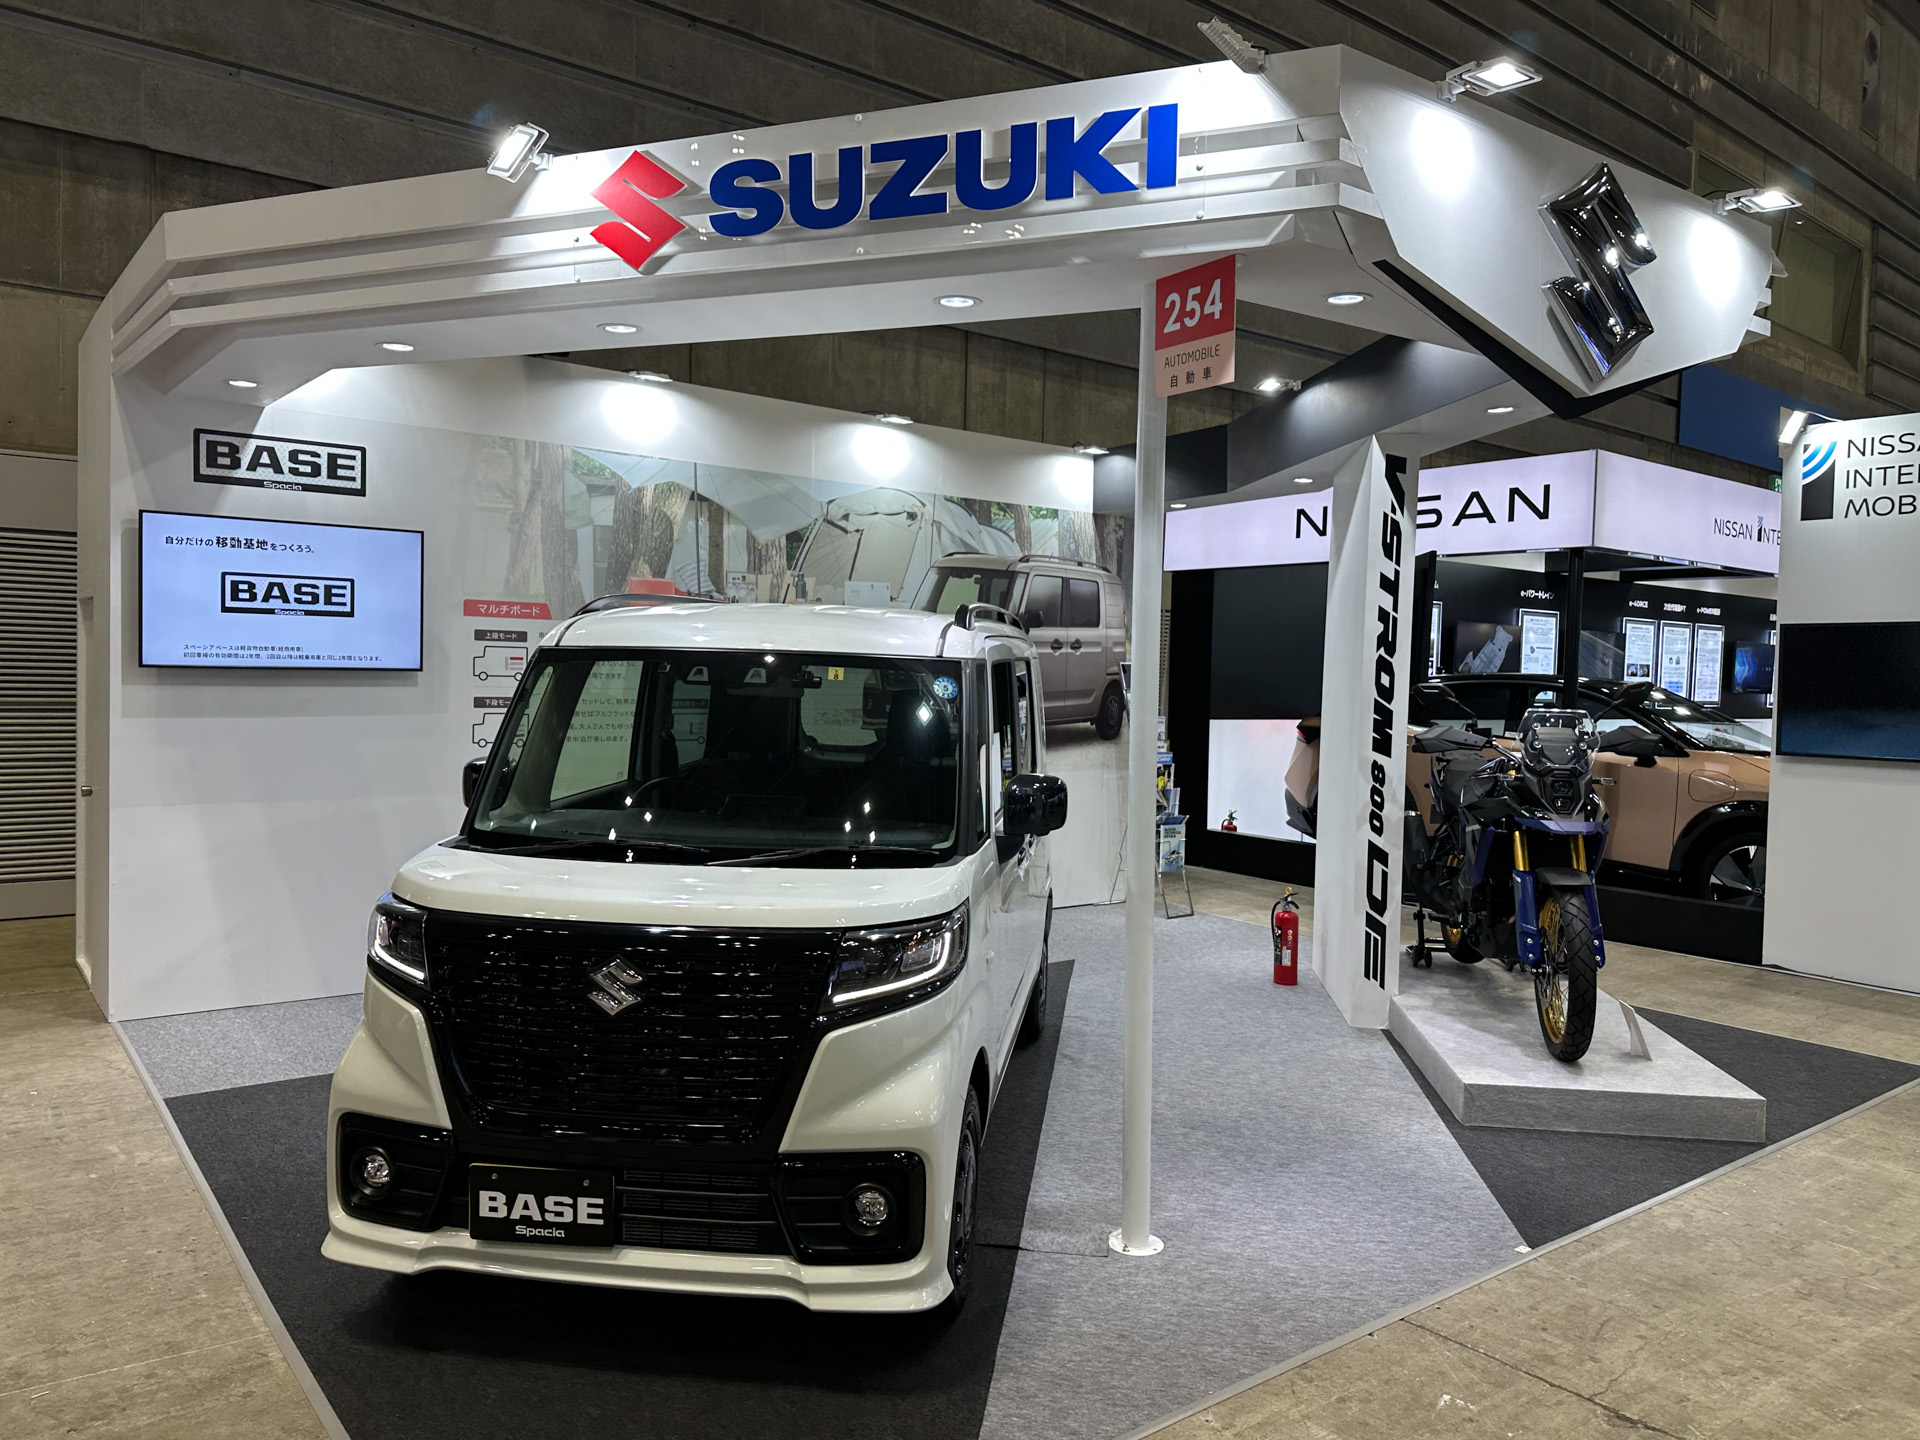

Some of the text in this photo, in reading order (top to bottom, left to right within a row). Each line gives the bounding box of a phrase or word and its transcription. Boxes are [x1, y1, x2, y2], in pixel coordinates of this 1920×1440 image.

[709, 103, 1178, 238] SUZUKI
[1163, 278, 1222, 333] 254
[1164, 344, 1220, 368] AUTOMOBILE
[1170, 367, 1212, 388] 自動車
[1847, 432, 1920, 459] NISS
[205, 440, 357, 481] BASE
[263, 481, 302, 491] Spacia
[1845, 463, 1920, 489] INTE
[1713, 517, 1753, 541] NISSAN
[165, 535, 315, 554] 自分だけの移動基地をつくろう。
[230, 580, 348, 607] BASE
[484, 631, 518, 640] 上段モード
[1368, 759, 1387, 838] 800
[479, 1190, 604, 1225] BASE
[515, 1225, 566, 1238] Spacia
